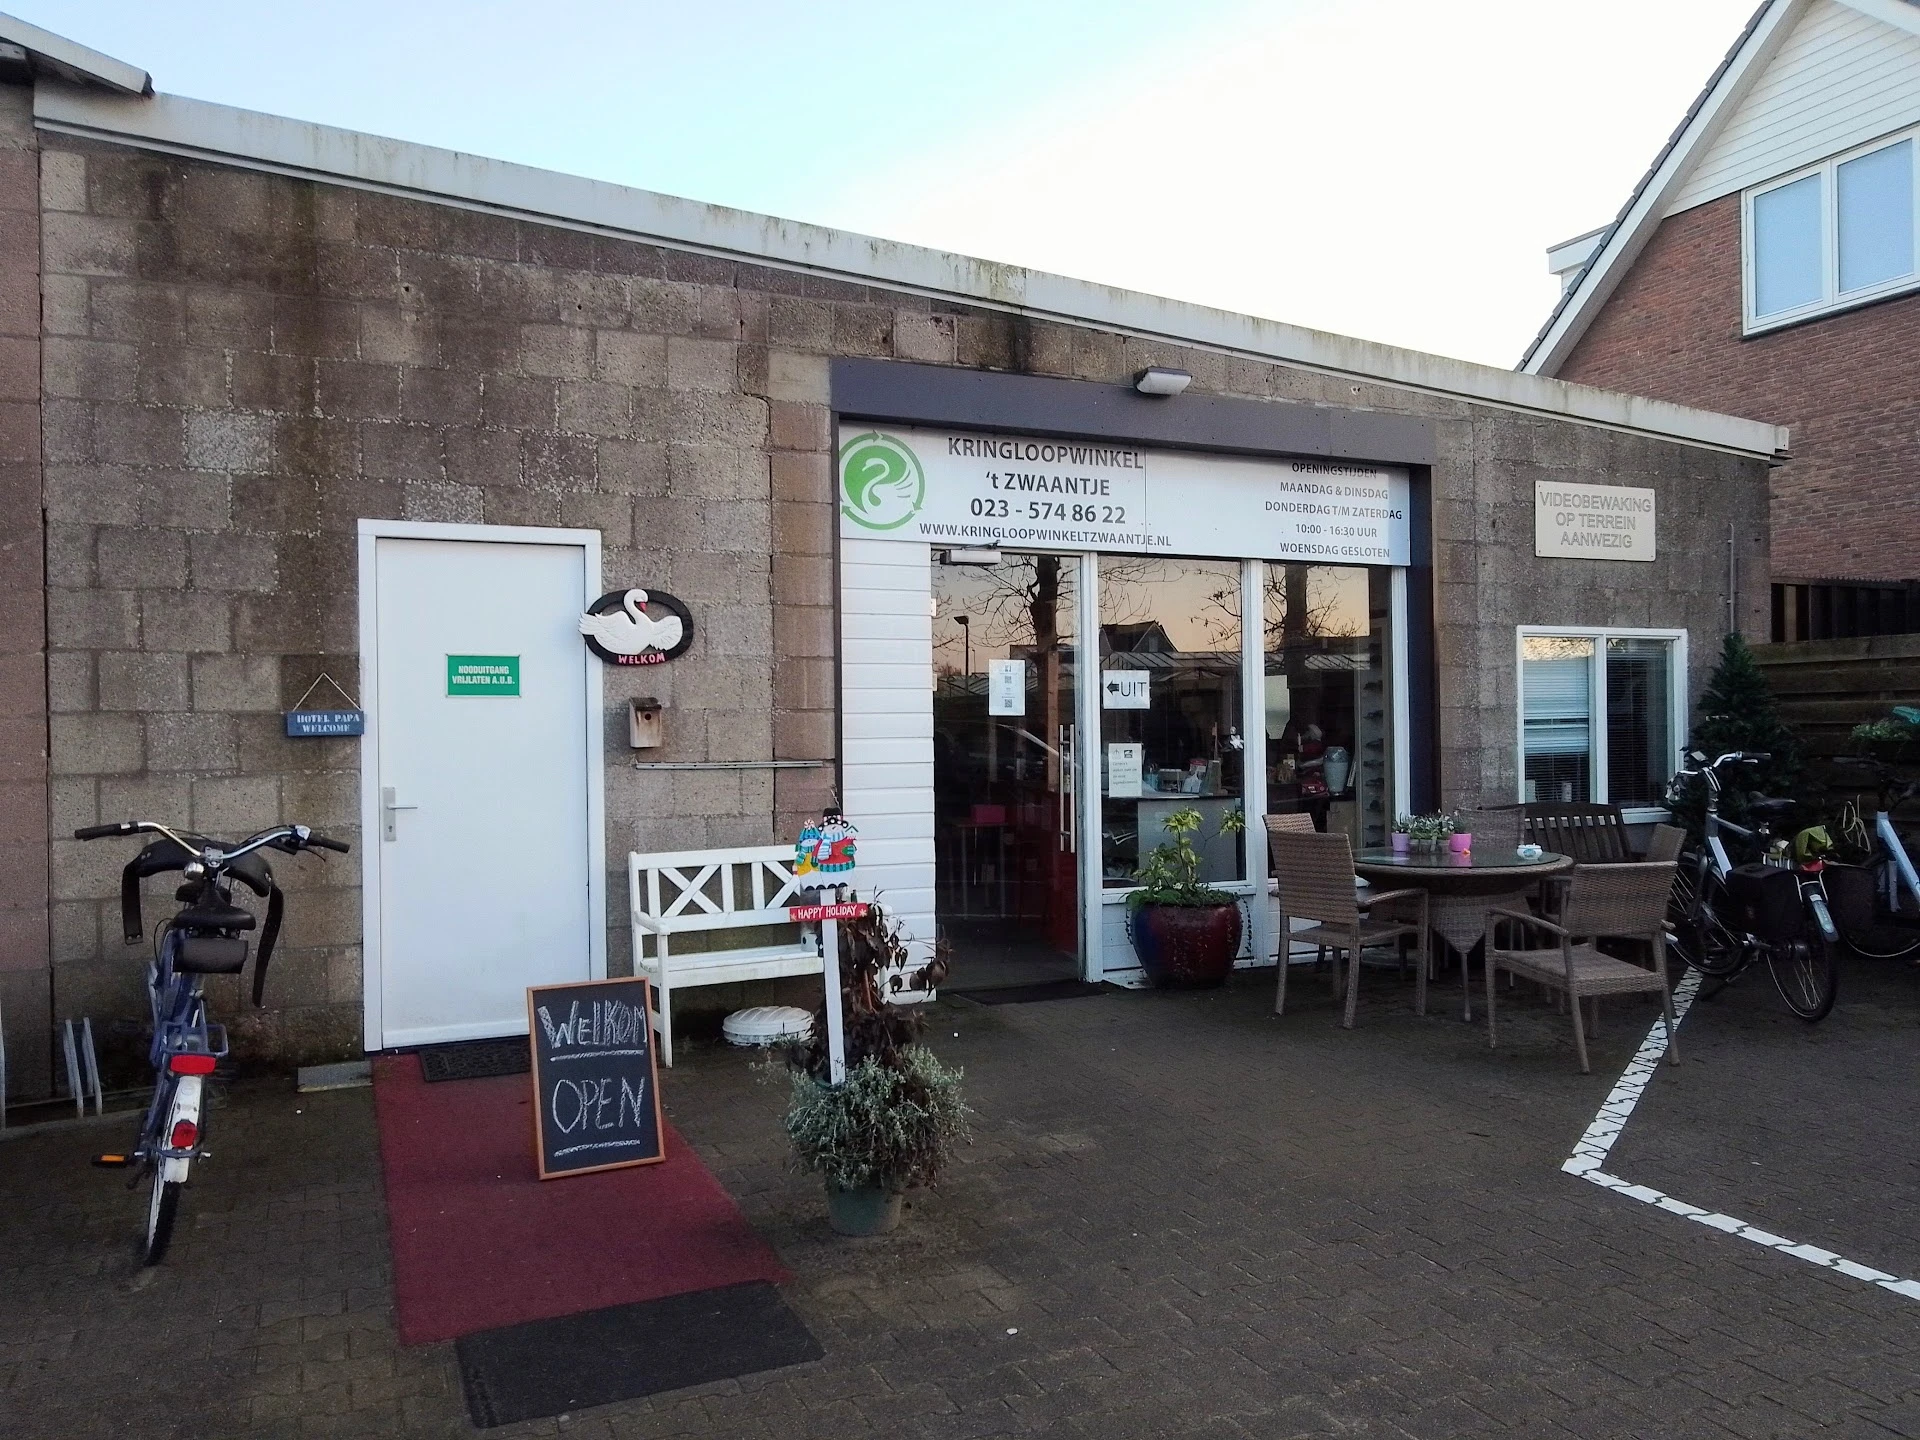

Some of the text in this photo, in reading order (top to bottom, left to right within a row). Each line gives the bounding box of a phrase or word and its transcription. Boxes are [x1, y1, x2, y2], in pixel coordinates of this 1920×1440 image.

[948, 437, 1144, 469] KRINGLOOPWINKEL
[1291, 462, 1377, 479] OPENINGSTIJDEN
[1004, 473, 1110, 496] ZWAANTJE
[1280, 482, 1389, 500] MAANDAG & DINSDAG
[1265, 501, 1402, 520] DONDERDAG T/M ZATERDAG
[1540, 491, 1652, 513] VIDEOBEWAKING
[970, 498, 1009, 518] 023
[1028, 501, 1066, 521] 574
[1071, 504, 1097, 523] 86
[1102, 506, 1126, 524] 22
[1555, 511, 1637, 530] OP TERREIN
[919, 523, 1173, 547] WWW.KRINGLOOPWINKELTZWAANTJE.NL
[1295, 524, 1322, 535] 10:00
[1329, 526, 1355, 537] 16:30
[1357, 528, 1378, 538] UUR
[1560, 530, 1634, 549] AANWEZIG
[1280, 542, 1390, 558] WOENSDAG GESLOTEN
[618, 652, 666, 665] WELKOM
[458, 665, 510, 675] NOODUITGANG
[451, 675, 491, 685] VRIJLATEN
[1120, 681, 1147, 697] UIT
[296, 713, 361, 723] HOTEL PAPA
[302, 724, 351, 733] WELCOME
[797, 904, 858, 919] HAPPY HOLIDAY
[552, 1075, 646, 1134] OPEN
